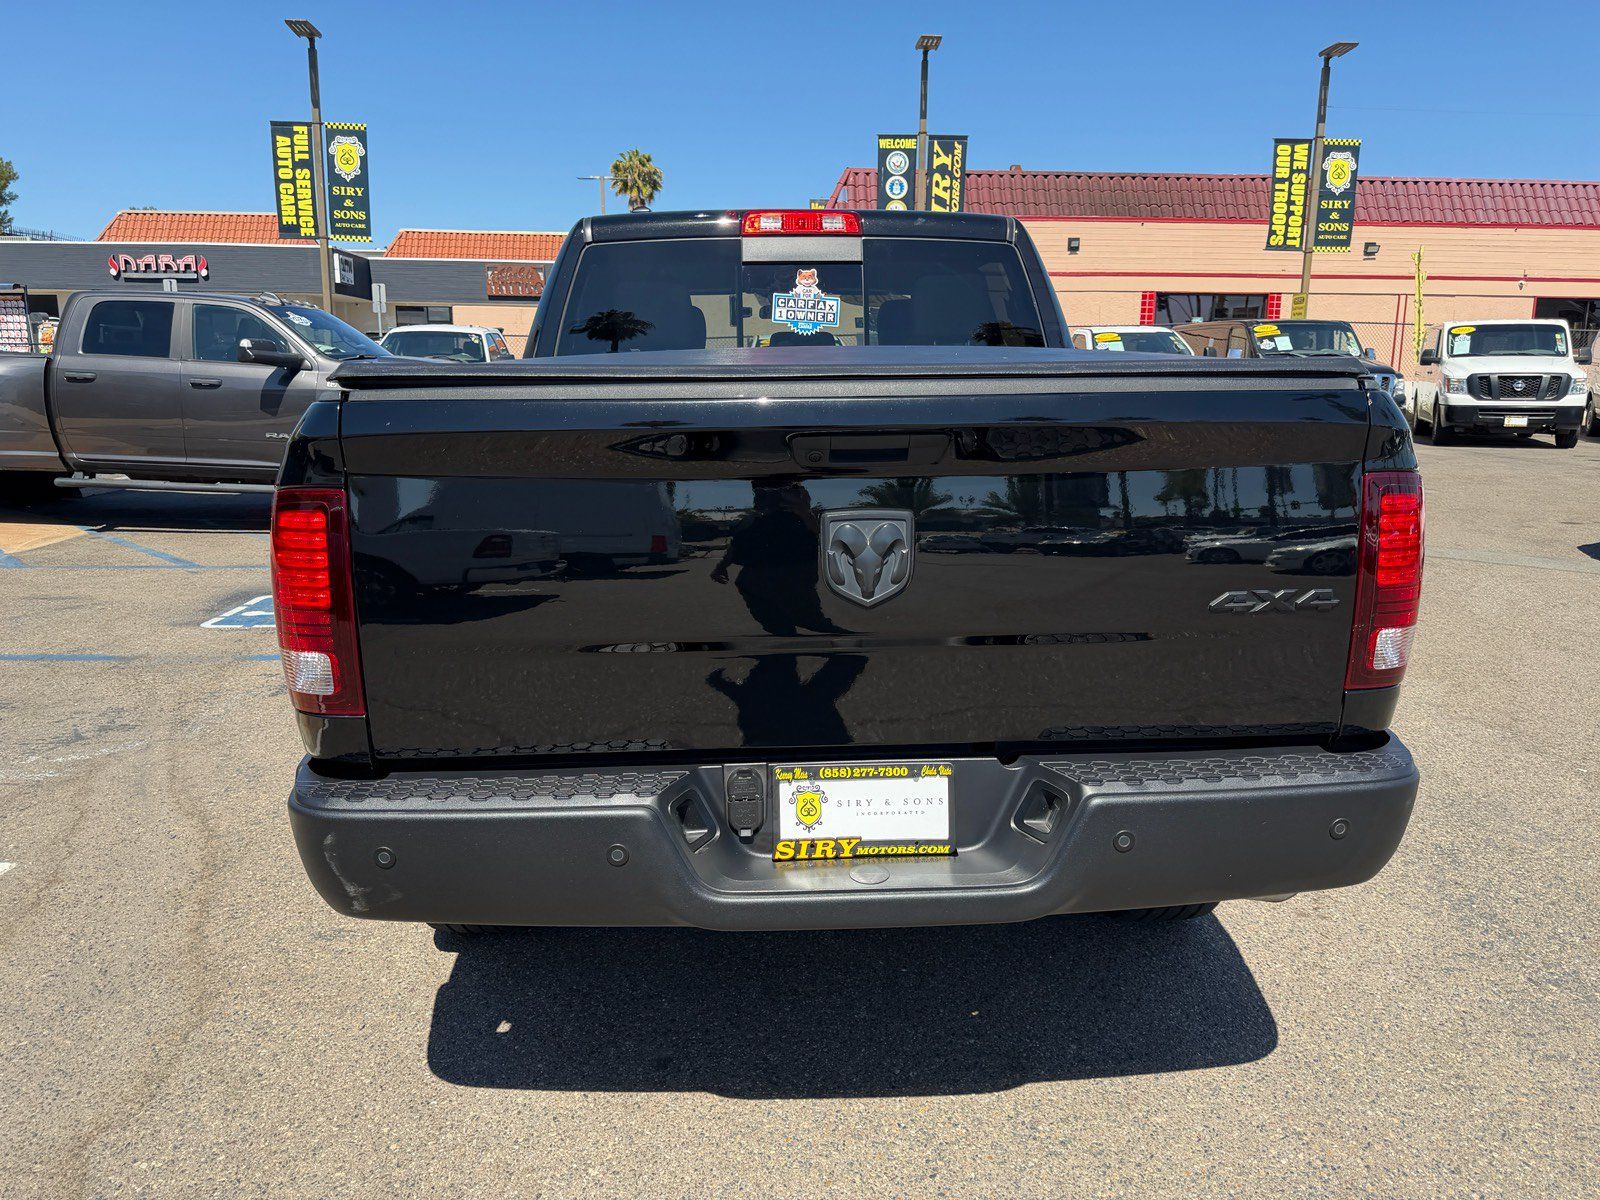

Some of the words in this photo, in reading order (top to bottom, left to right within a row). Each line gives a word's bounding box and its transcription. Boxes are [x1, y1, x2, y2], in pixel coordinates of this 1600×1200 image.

[293, 126, 309, 161] FULL
[879, 138, 917, 149] WELCOME
[276, 135, 293, 179] AUTO
[1275, 144, 1292, 179] OUR
[1293, 143, 1309, 170] WE
[332, 186, 364, 196] SIRY
[279, 182, 297, 225] CARE
[295, 168, 315, 236] SERVICE
[343, 199, 354, 207] &
[1320, 200, 1351, 209] SIRY
[333, 210, 366, 220] SONS
[1269, 181, 1289, 246] TROOPS
[1286, 172, 1307, 248] SUPPORT
[1318, 222, 1349, 232] SONS
[777, 299, 834, 312] CARFAX
[778, 310, 784, 318] 1
[787, 310, 835, 322] OWNER
[819, 766, 851, 779] (858)
[852, 765, 909, 777] 277-7300
[837, 799, 872, 808] SIRY
[903, 798, 943, 806] SONS
[774, 838, 861, 861] SIRY
[857, 845, 950, 856] MOTORS.COM
